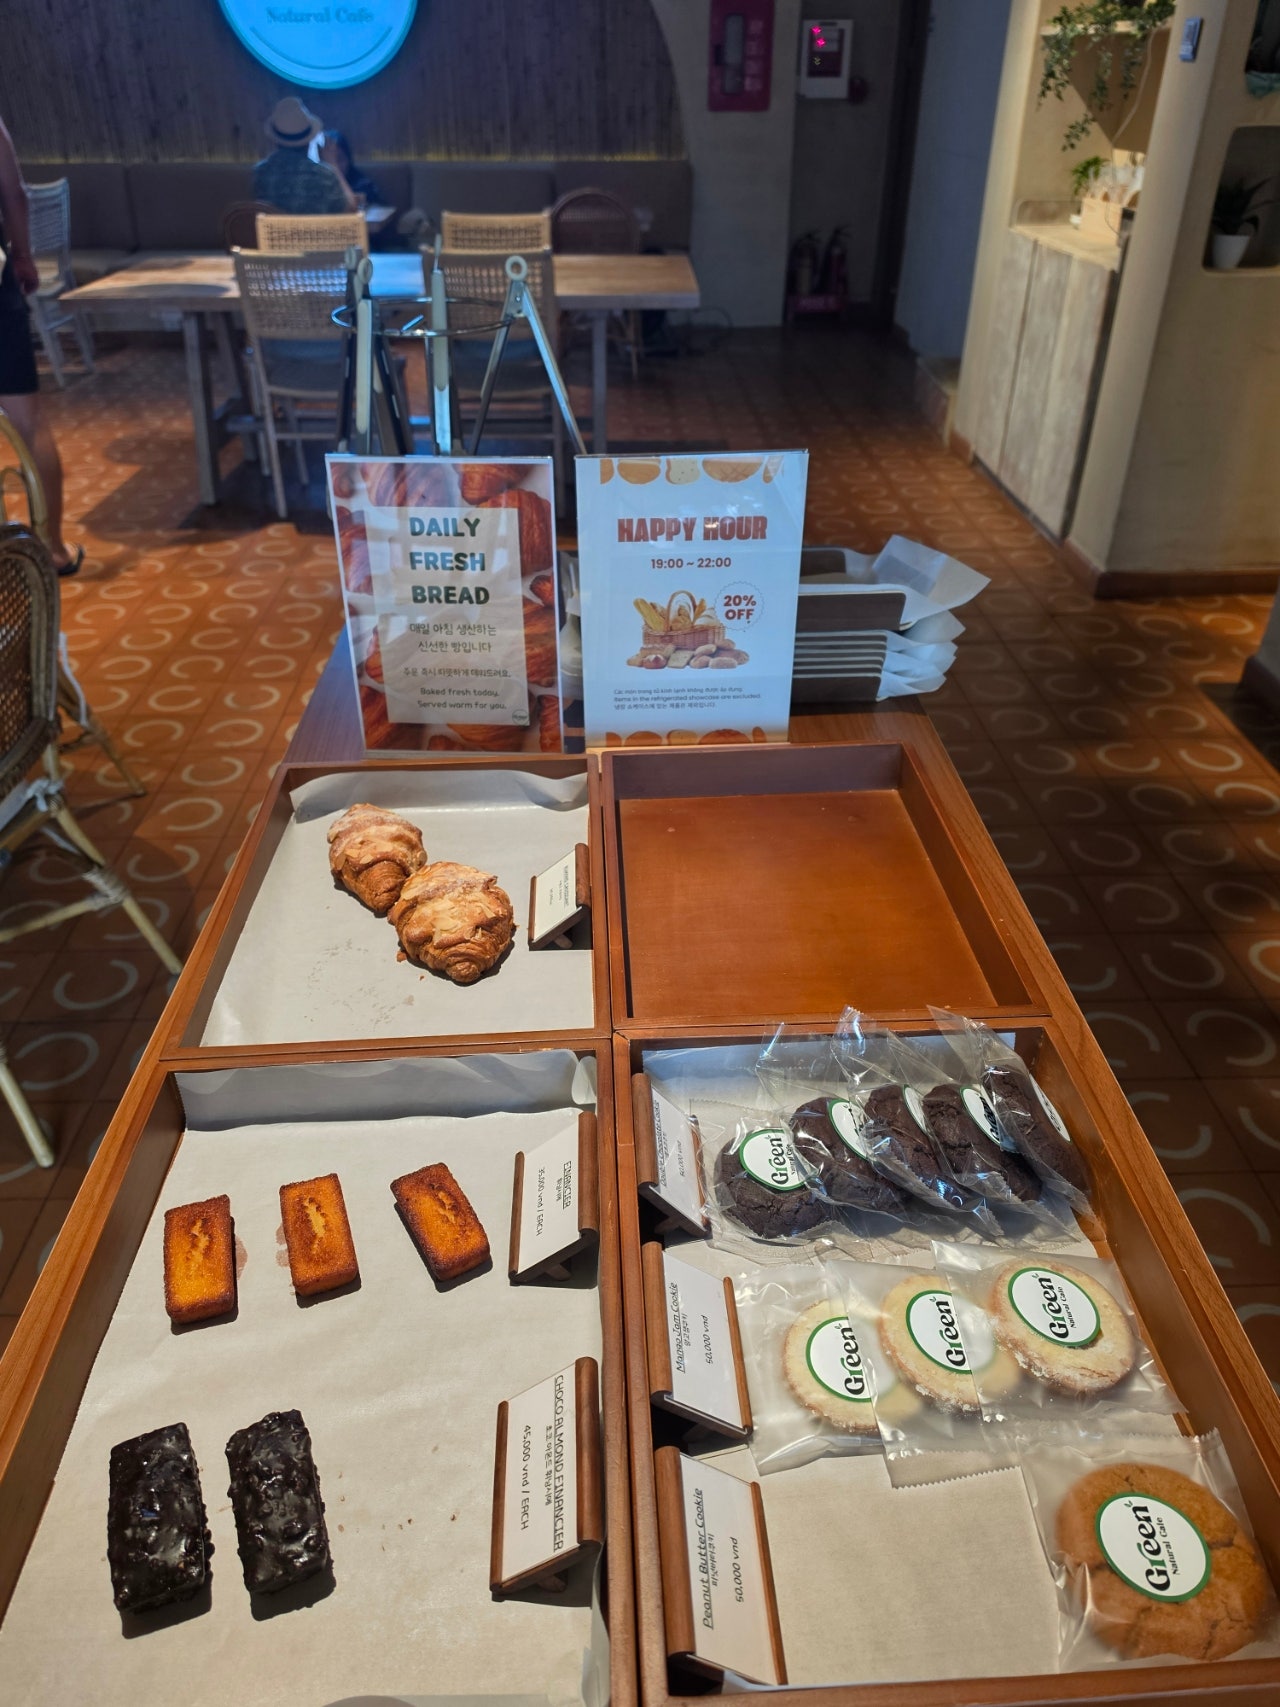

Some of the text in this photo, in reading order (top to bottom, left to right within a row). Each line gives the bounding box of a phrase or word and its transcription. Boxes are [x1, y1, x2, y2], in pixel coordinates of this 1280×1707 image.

[266, 7, 375, 24] Natural Cafe
[409, 517, 481, 538] DAILY
[617, 514, 769, 543] HAPPY HOUR
[409, 551, 486, 572] FRESH
[651, 557, 684, 569] 19:00
[697, 556, 732, 569] 22:00
[411, 585, 490, 606] BREAD
[723, 594, 757, 607] 20%
[724, 608, 755, 621] OFF
[409, 623, 497, 636] 매일 아침 생산하는
[418, 640, 492, 653] 신선한 빵입니다
[420, 687, 446, 696] Baked
[448, 687, 471, 696] fresh
[417, 700, 447, 709] Served
[475, 701, 487, 709] for
[489, 702, 507, 710] you.
[769, 1138, 789, 1184] Green
[563, 1160, 571, 1209] FINANCIER
[536, 1213, 544, 1236] EACH
[1038, 1277, 1069, 1338] Green
[1062, 1303, 1077, 1329] Natural
[669, 1282, 686, 1374] Mango Jam Cookie
[701, 1314, 710, 1333] vnd
[936, 1301, 966, 1367] Green
[840, 1327, 865, 1395] Green
[522, 1425, 531, 1462] 45,000
[521, 1464, 530, 1487] vnd
[554, 1375, 564, 1552] CHOCO ALMOND FINANCIER
[520, 1497, 530, 1531] EACH
[730, 1536, 740, 1560] vnd
[1132, 1505, 1171, 1591] Green
[1157, 1517, 1180, 1575] Natural Cafe
[693, 1488, 714, 1630] Peanut Butter Cookie
